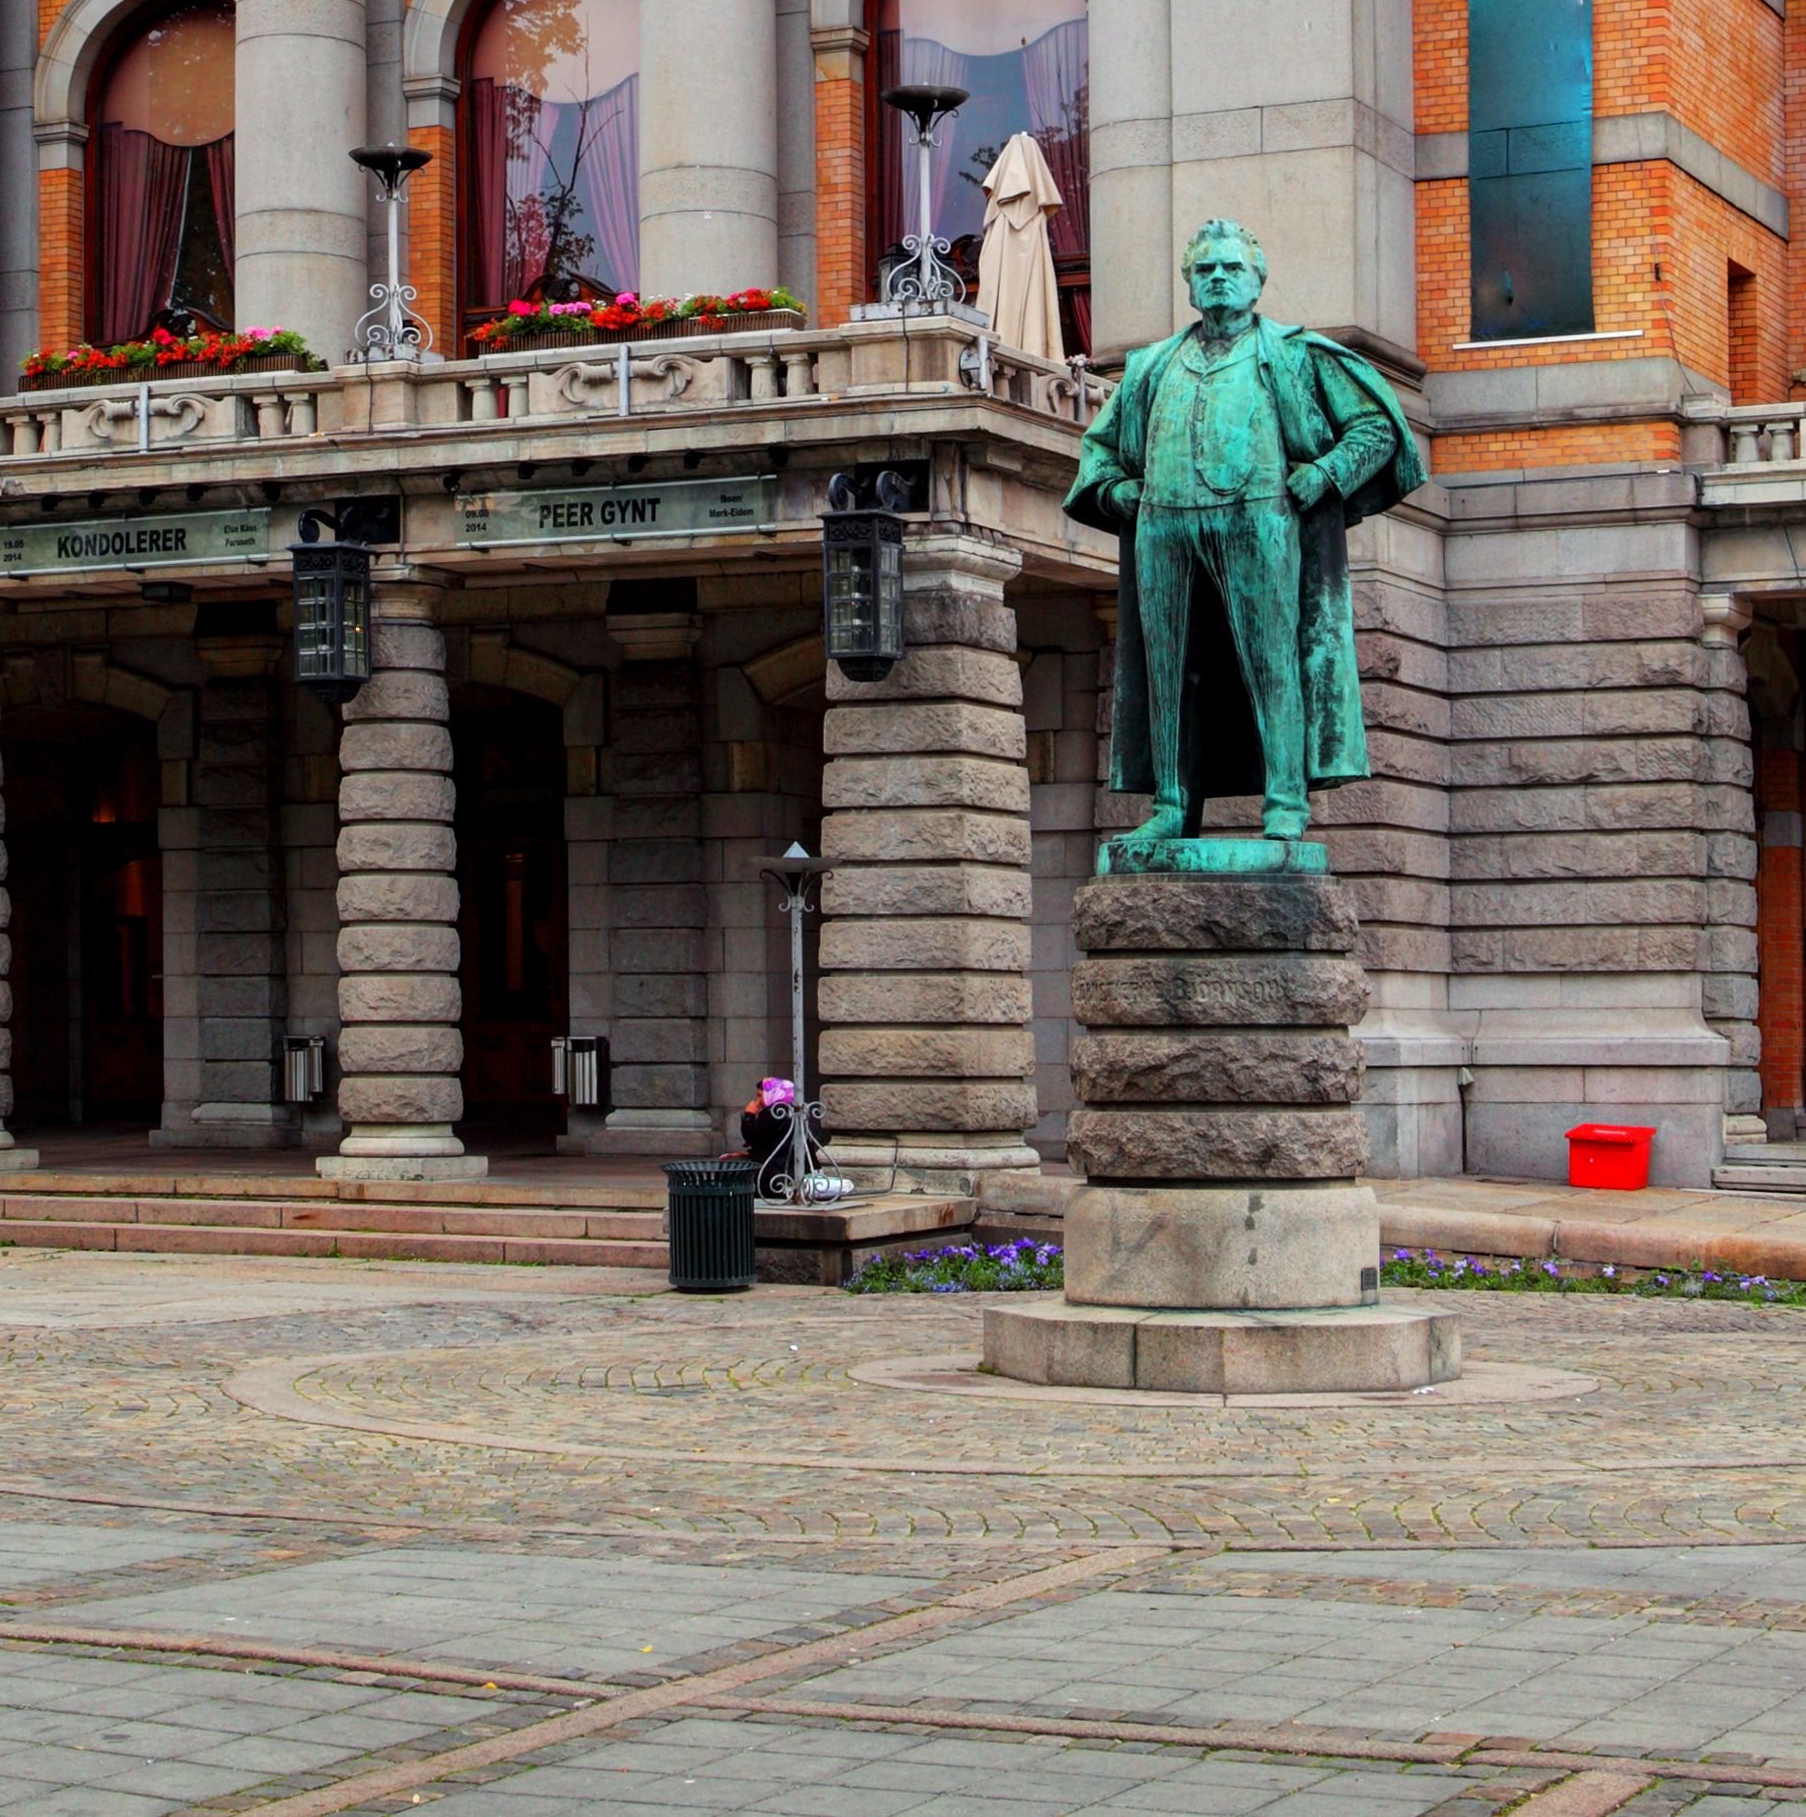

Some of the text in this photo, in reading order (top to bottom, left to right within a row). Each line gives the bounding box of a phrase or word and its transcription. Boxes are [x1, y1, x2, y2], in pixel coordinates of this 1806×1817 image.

[465, 522, 487, 532] 2014
[539, 498, 661, 529] PEER GYNT
[57, 527, 187, 559] KONDOLERER
